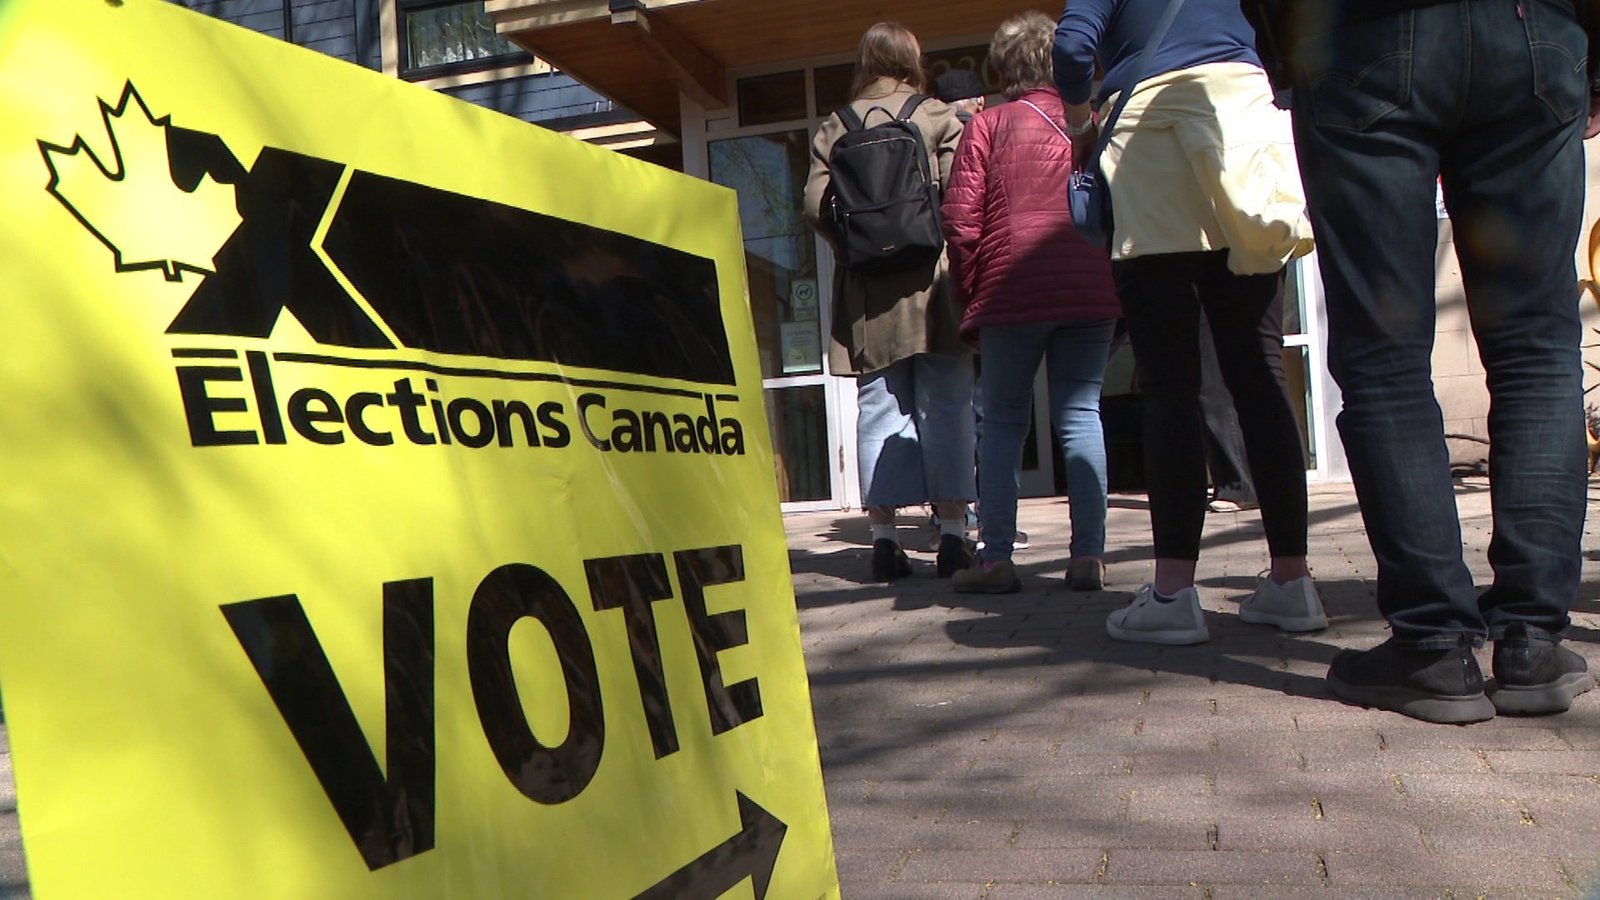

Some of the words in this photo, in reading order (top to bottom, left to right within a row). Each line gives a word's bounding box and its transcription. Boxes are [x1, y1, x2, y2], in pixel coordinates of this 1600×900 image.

[175, 350, 571, 448] Elections
[577, 392, 746, 456] Canada
[219, 544, 764, 872] VOTE
